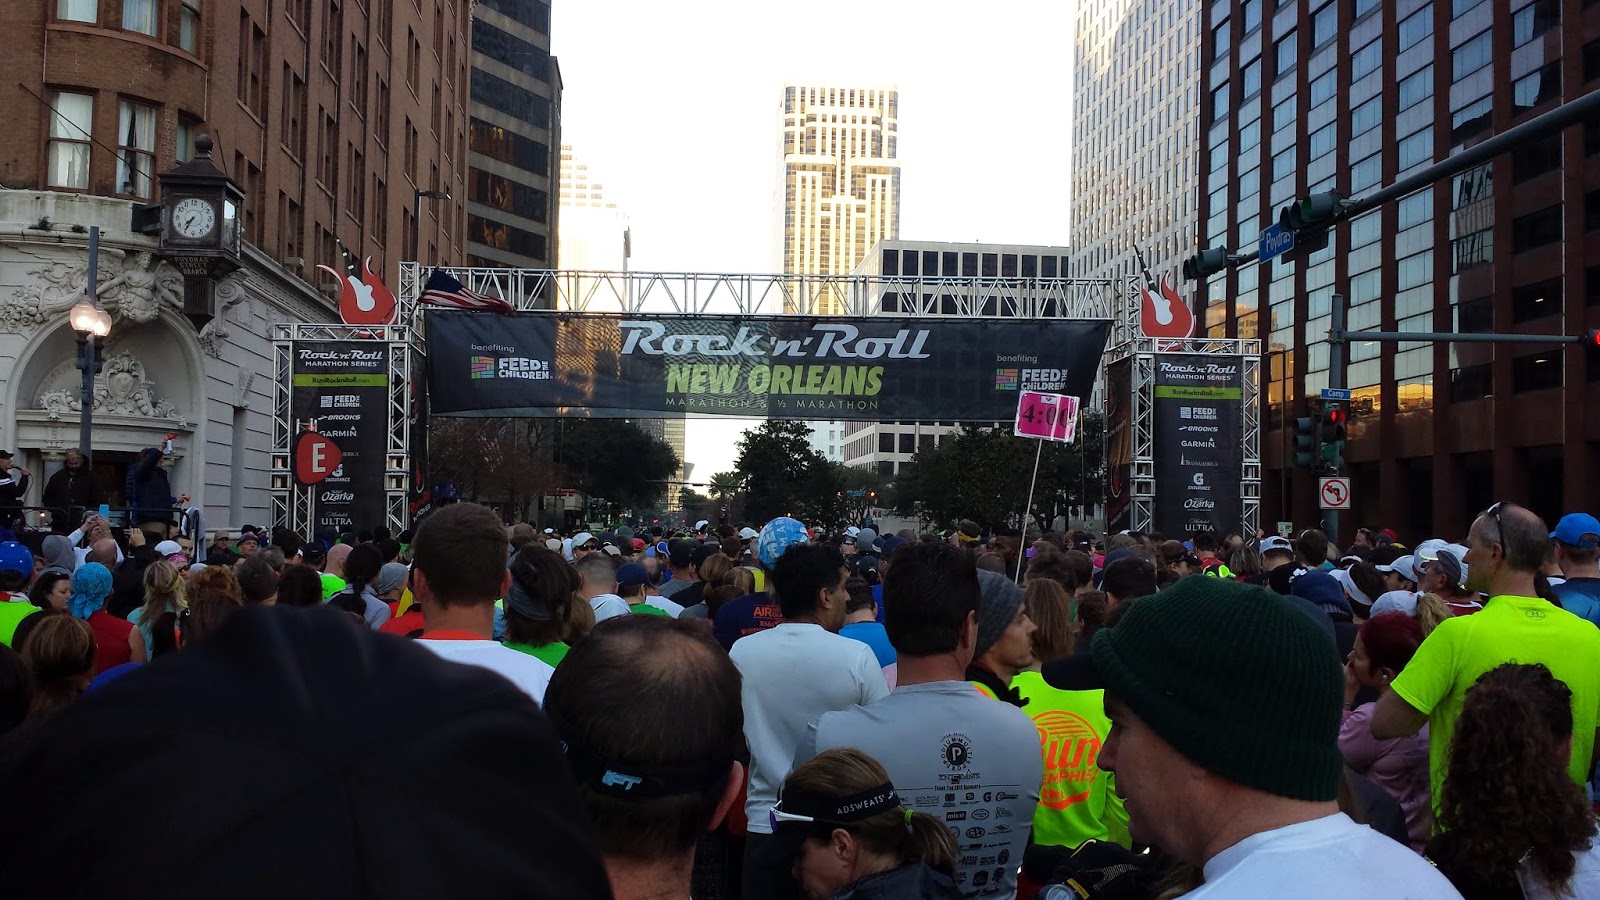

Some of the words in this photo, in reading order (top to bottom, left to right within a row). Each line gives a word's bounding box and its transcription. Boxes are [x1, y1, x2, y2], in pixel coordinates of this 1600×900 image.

[1266, 232, 1291, 253] Poydras
[471, 343, 515, 353] benefiting
[499, 357, 542, 371] FEED
[997, 354, 1038, 364] benefiting
[666, 364, 740, 394] NEW
[748, 364, 884, 396] ORLEANS
[1021, 368, 1061, 382] FEED
[1165, 373, 1205, 381] MARATHON
[1172, 388, 1225, 396] RunRocknRoll.com
[1327, 389, 1345, 399] Camp
[334, 395, 356, 403] FEED
[666, 398, 748, 408] MARATHON
[759, 400, 767, 408] &
[796, 400, 878, 410] MARATHON
[1192, 407, 1213, 415] FEED
[320, 429, 358, 437] GARMIN
[1180, 439, 1215, 448] GARMIN
[312, 443, 326, 473] E
[1193, 472, 1204, 486] G
[321, 491, 354, 502] Ozarka
[1183, 499, 1215, 509] Ozarka
[321, 518, 353, 526] ULTRA
[1184, 524, 1215, 532] ULTRA
[753, 606, 772, 617] AIR
[951, 746, 962, 762] P
